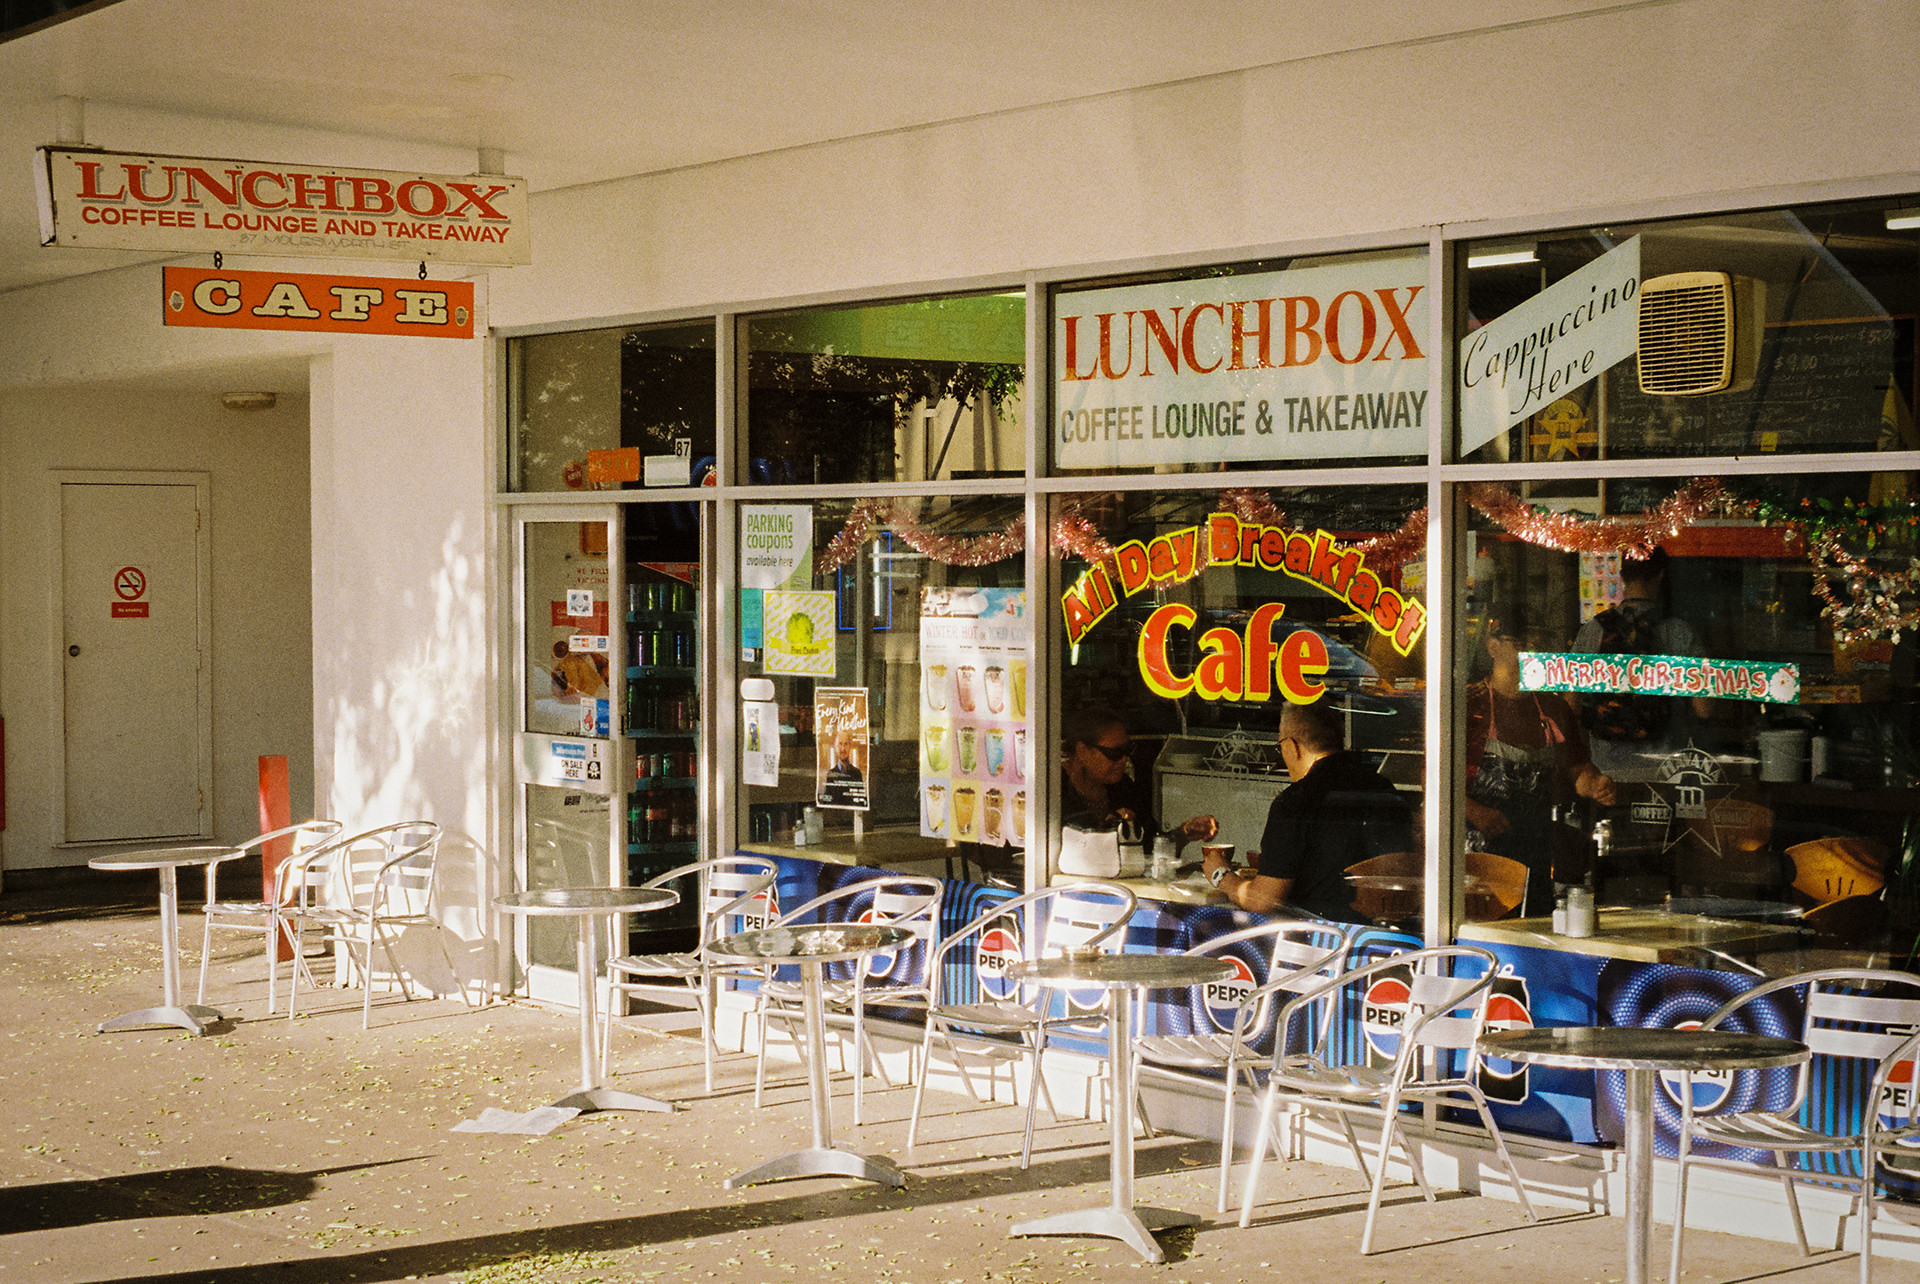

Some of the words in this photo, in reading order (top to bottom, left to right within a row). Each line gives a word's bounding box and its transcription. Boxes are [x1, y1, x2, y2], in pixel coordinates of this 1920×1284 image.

[75, 161, 510, 221] LUNCHBOX
[82, 206, 196, 227] COFFEE
[204, 211, 318, 233] LOUNGE
[324, 218, 377, 237] AND
[382, 221, 510, 244] TAKEAWAY
[193, 278, 450, 326] CAFE
[1060, 286, 1427, 382] LUNCHBOX
[1463, 276, 1638, 388] Cappuccino
[1510, 346, 1595, 415] Here
[1061, 405, 1143, 443] COFFEE
[1152, 400, 1246, 439] LOUNGE
[1255, 400, 1273, 435] &
[1284, 390, 1429, 433] TAKEAWAY
[676, 441, 690, 457] 87
[747, 514, 793, 533] PARKING
[746, 534, 794, 553] coupons
[746, 554, 778, 567] available
[779, 555, 794, 567] here
[1061, 562, 1119, 648] All
[1114, 526, 1199, 598] Day
[1208, 512, 1427, 657] Breakfast
[961, 625, 978, 640] HOT
[1138, 602, 1329, 706] Cafe
[1545, 656, 1626, 688] MERRY
[1626, 657, 1769, 698] CHRISTMAS
[561, 759, 569, 768] ON
[570, 760, 583, 770] SALE
[565, 769, 579, 778] HERE
[1633, 806, 1669, 819] COFFEE
[979, 953, 1019, 971] PEP
[1207, 984, 1254, 1006] PEPS
[1366, 1006, 1405, 1027] PEP
